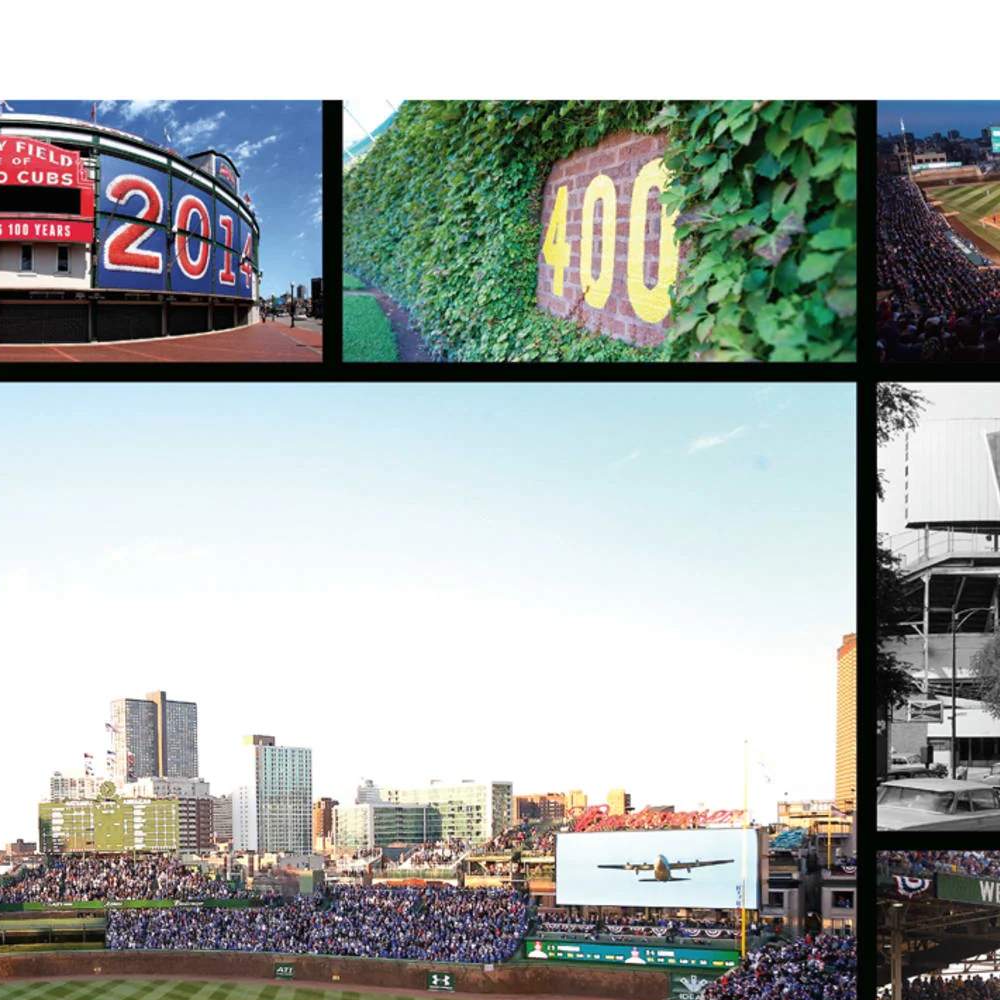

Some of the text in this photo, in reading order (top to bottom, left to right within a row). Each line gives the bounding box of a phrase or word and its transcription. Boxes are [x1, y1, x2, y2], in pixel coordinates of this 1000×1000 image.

[11, 157, 32, 166] OF
[16, 141, 73, 168] FIELD
[17, 171, 73, 186] CUBS
[8, 223, 29, 237] 100
[34, 224, 71, 237] YEARS
[104, 174, 253, 289] 2014
[542, 157, 680, 323] 400
